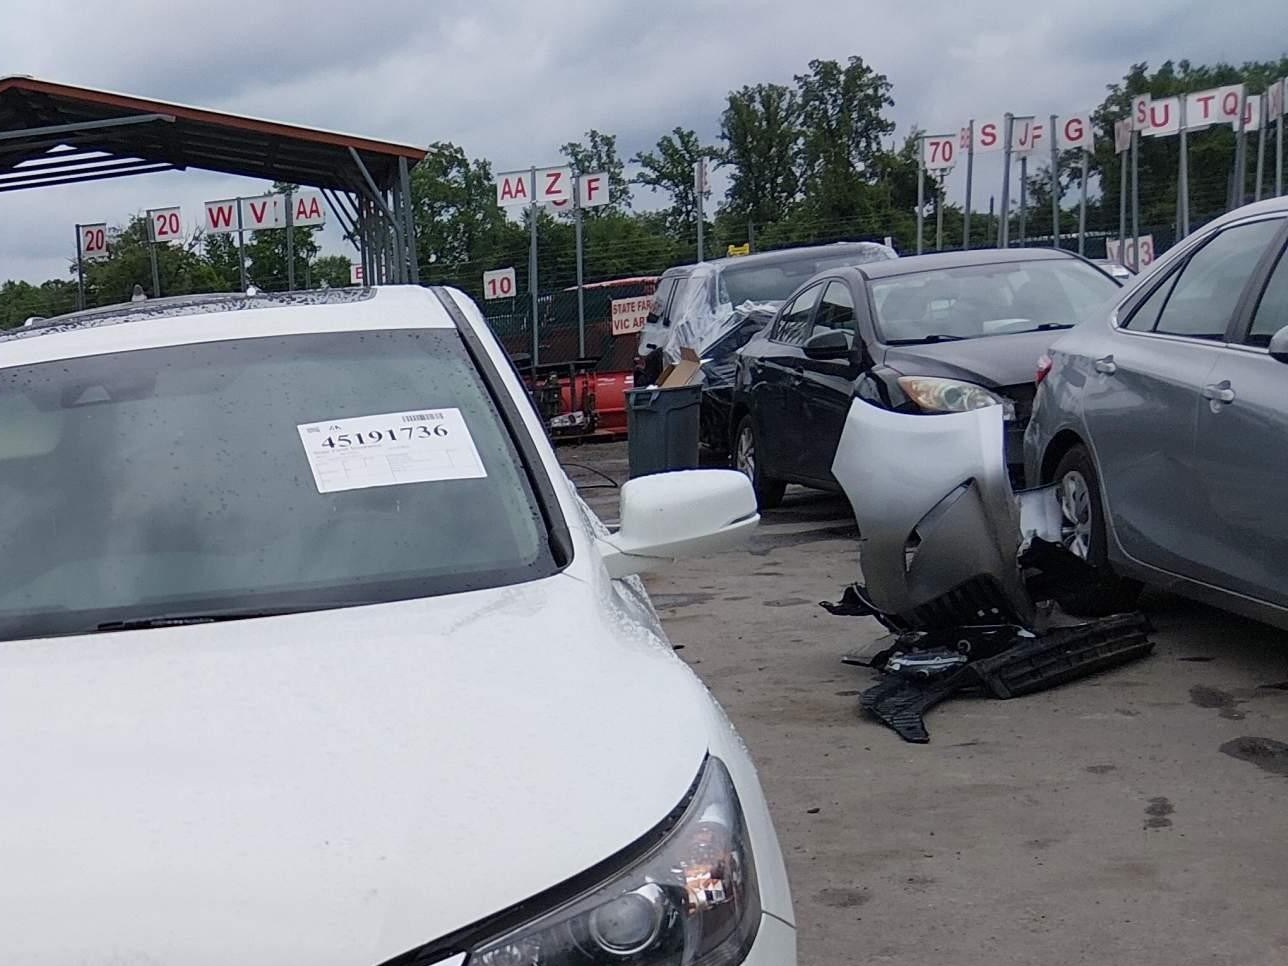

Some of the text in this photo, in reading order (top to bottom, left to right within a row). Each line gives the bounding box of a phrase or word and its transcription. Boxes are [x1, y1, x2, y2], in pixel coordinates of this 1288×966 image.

[1137, 101, 1146, 123] S
[1150, 104, 1169, 128] U
[1196, 95, 1215, 119] T
[980, 123, 997, 147] S
[1064, 118, 1083, 142] G
[929, 140, 953, 163] 70
[500, 176, 527, 200] AA
[545, 172, 562, 195] Z
[587, 177, 601, 201] F
[208, 205, 233, 228] W
[250, 202, 267, 223] V
[296, 197, 321, 220] AA
[156, 213, 180, 236] 20
[85, 229, 104, 251] 20
[488, 277, 511, 296] 10
[613, 299, 657, 315] STATE FAR
[614, 318, 630, 330] VIC
[321, 424, 449, 449] 45191736
